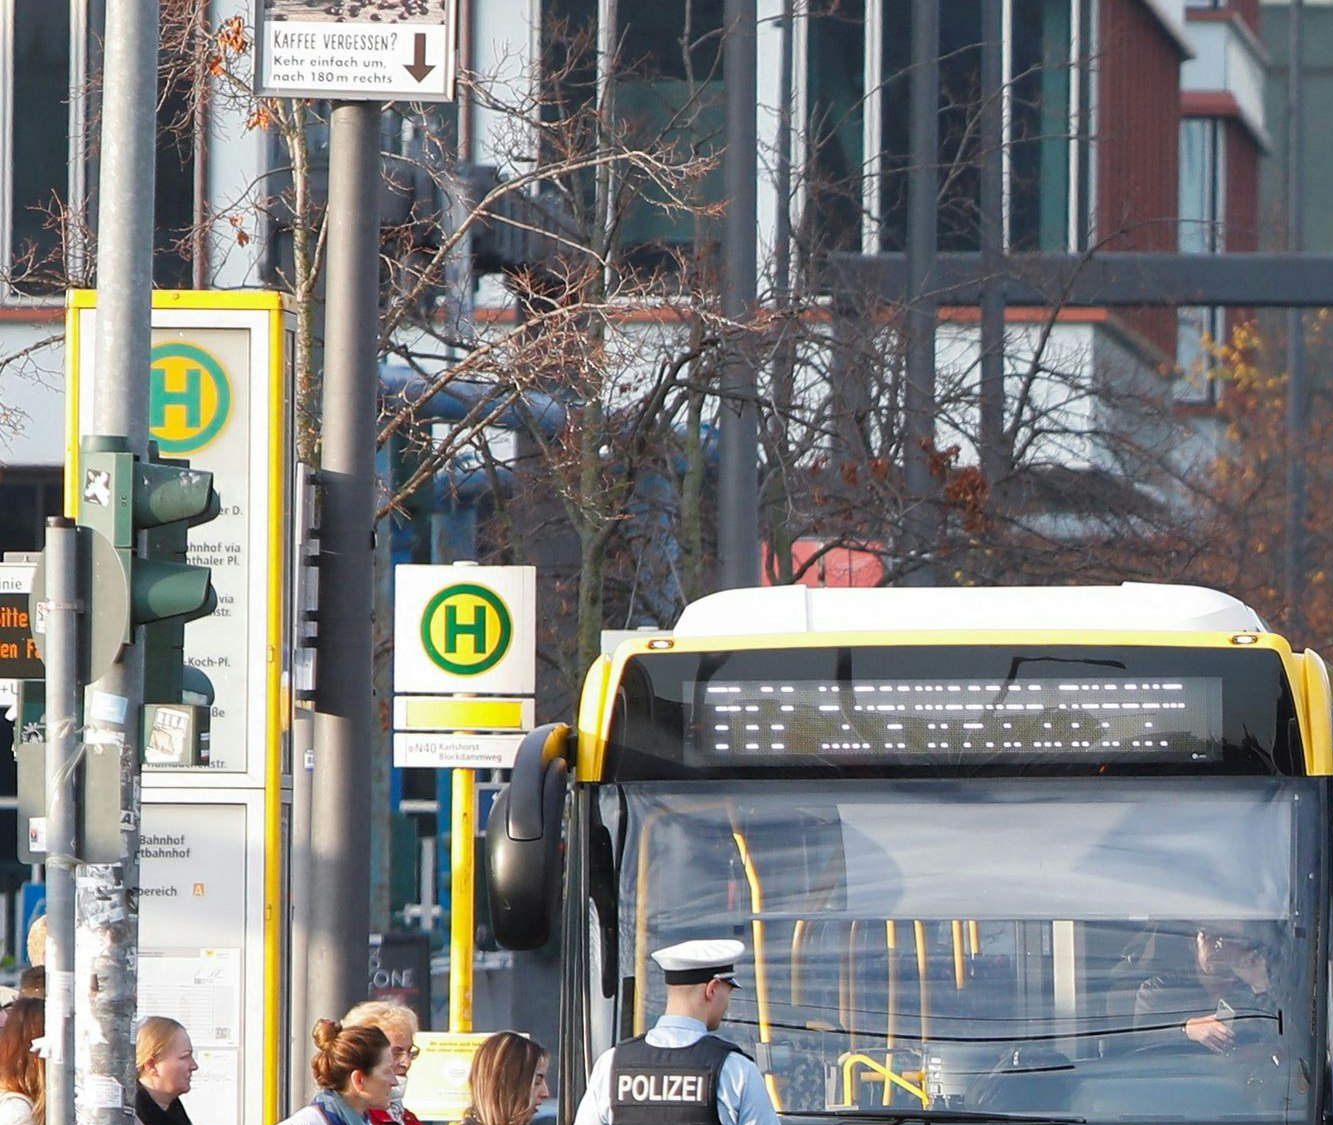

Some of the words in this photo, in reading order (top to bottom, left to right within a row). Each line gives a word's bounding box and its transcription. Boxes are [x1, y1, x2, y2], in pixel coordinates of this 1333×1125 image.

[273, 30, 316, 49] KAFFEE
[323, 32, 397, 51] VERGESSEN?
[273, 56, 305, 66] Kehr
[309, 56, 358, 68] einfach
[363, 60, 387, 69] um,
[273, 72, 305, 82] nach
[353, 73, 393, 84] rechts
[224, 543, 241, 552] via
[618, 1074, 703, 1102] POLIZEI
